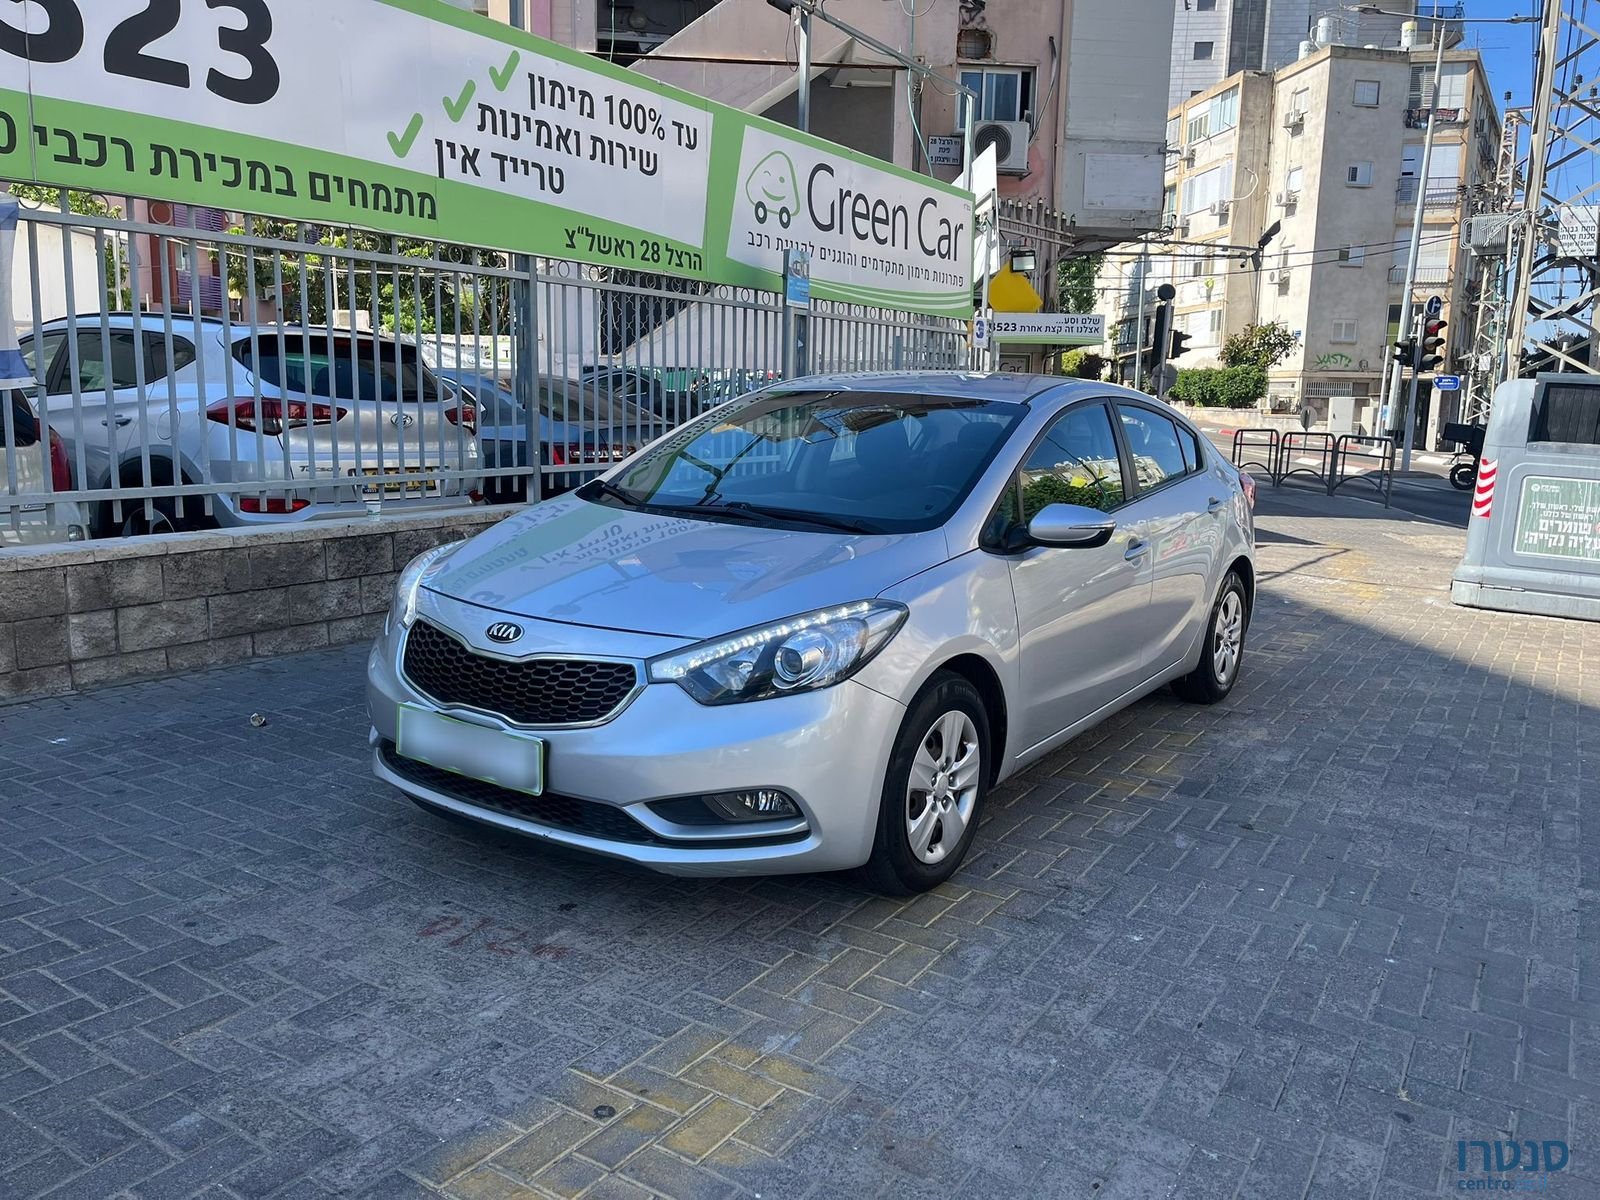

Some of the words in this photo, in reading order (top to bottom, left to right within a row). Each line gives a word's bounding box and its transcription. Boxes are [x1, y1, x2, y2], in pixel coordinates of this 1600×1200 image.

[528, 72, 595, 119] מימון
[477, 103, 581, 157] ואמינות
[604, 95, 665, 140] 100%
[33, 125, 135, 172] רכבי
[672, 120, 698, 150] עד
[434, 139, 481, 179] אין
[590, 134, 658, 177] שירות
[150, 143, 297, 198] במכירת
[490, 151, 564, 194] טרייד
[308, 171, 437, 220] מתמחים
[807, 163, 909, 250] Green
[918, 197, 963, 262] Car
[640, 239, 661, 263] 28
[747, 231, 771, 249] רכב
[665, 243, 702, 271] הרצל
[820, 247, 857, 267] והוגנים
[861, 255, 904, 276] מתקדמים
[907, 264, 930, 280] מימון
[932, 270, 964, 287] פתרונות
[1045, 325, 1063, 334] קצת
[1076, 325, 1100, 334] אצלנו
[1082, 316, 1100, 325] שלם
[1539, 519, 1592, 535] שומרים
[489, 623, 517, 639] KIA
